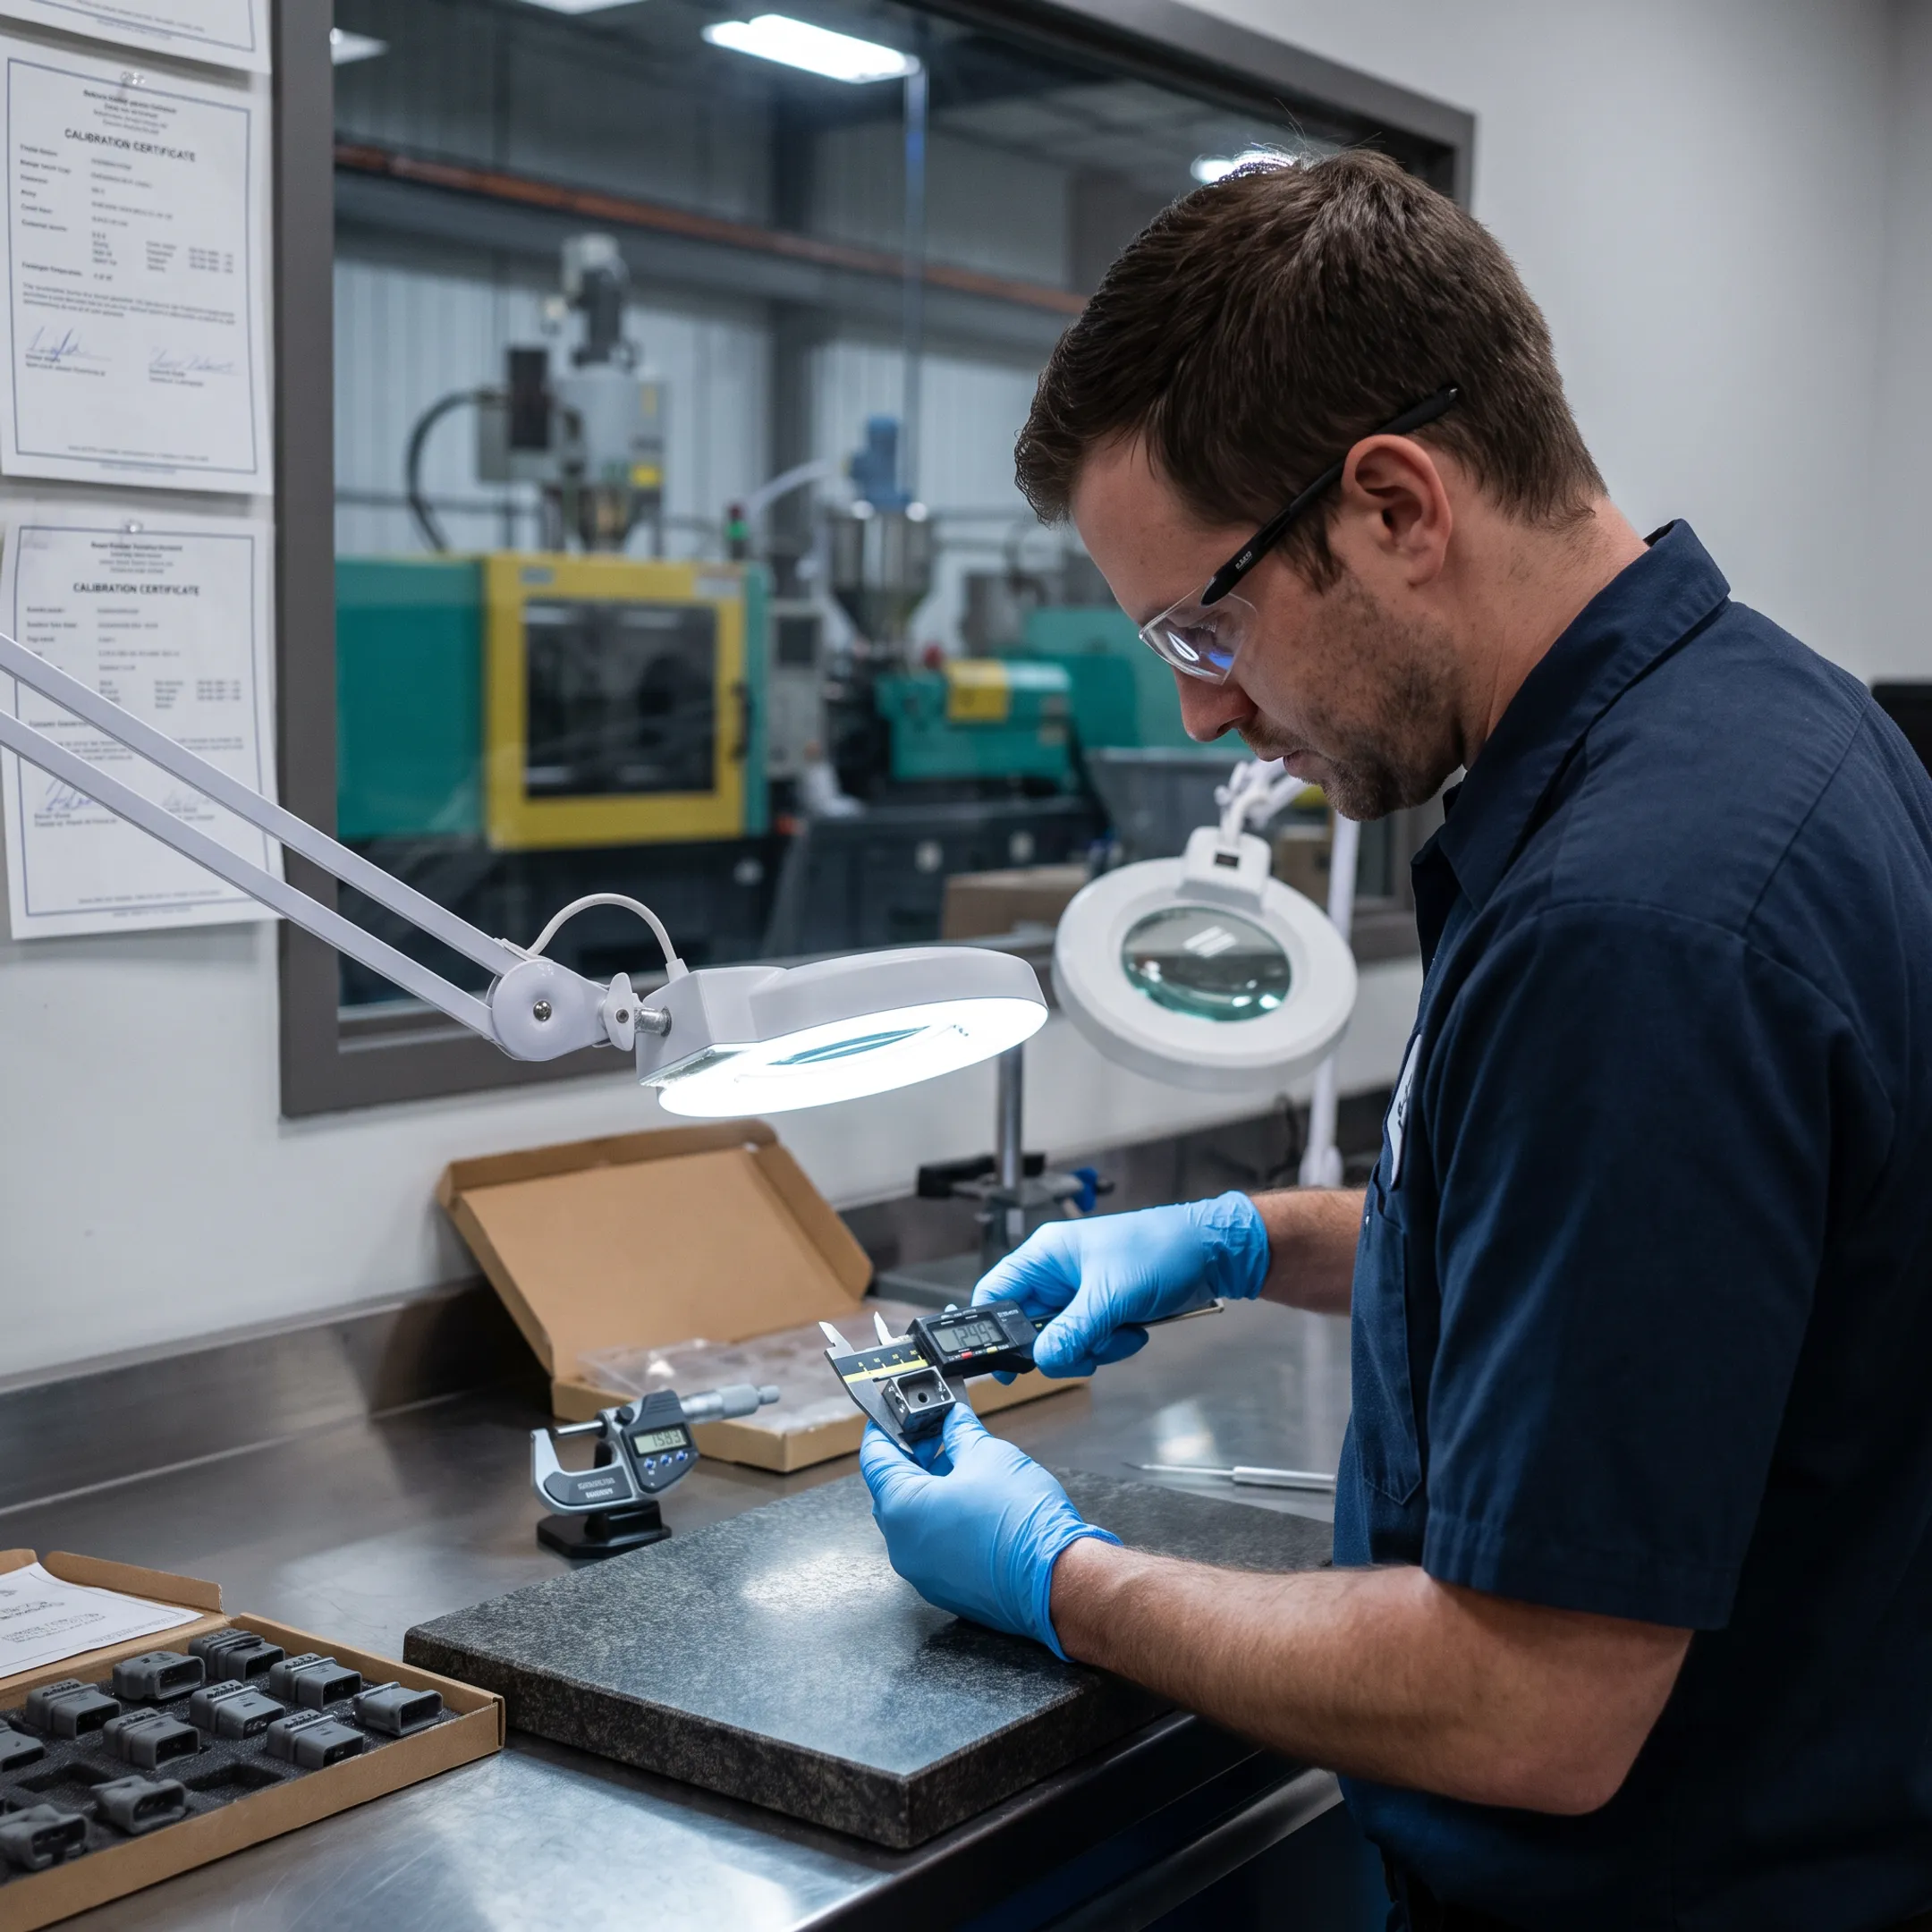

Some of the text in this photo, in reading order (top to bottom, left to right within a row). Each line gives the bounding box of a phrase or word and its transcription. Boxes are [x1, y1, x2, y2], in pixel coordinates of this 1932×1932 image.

[64, 128, 131, 150] CALIBRATION
[133, 140, 195, 162] CERTIFICATE
[72, 582, 199, 596] CALIBRATION CERTIFICATE
